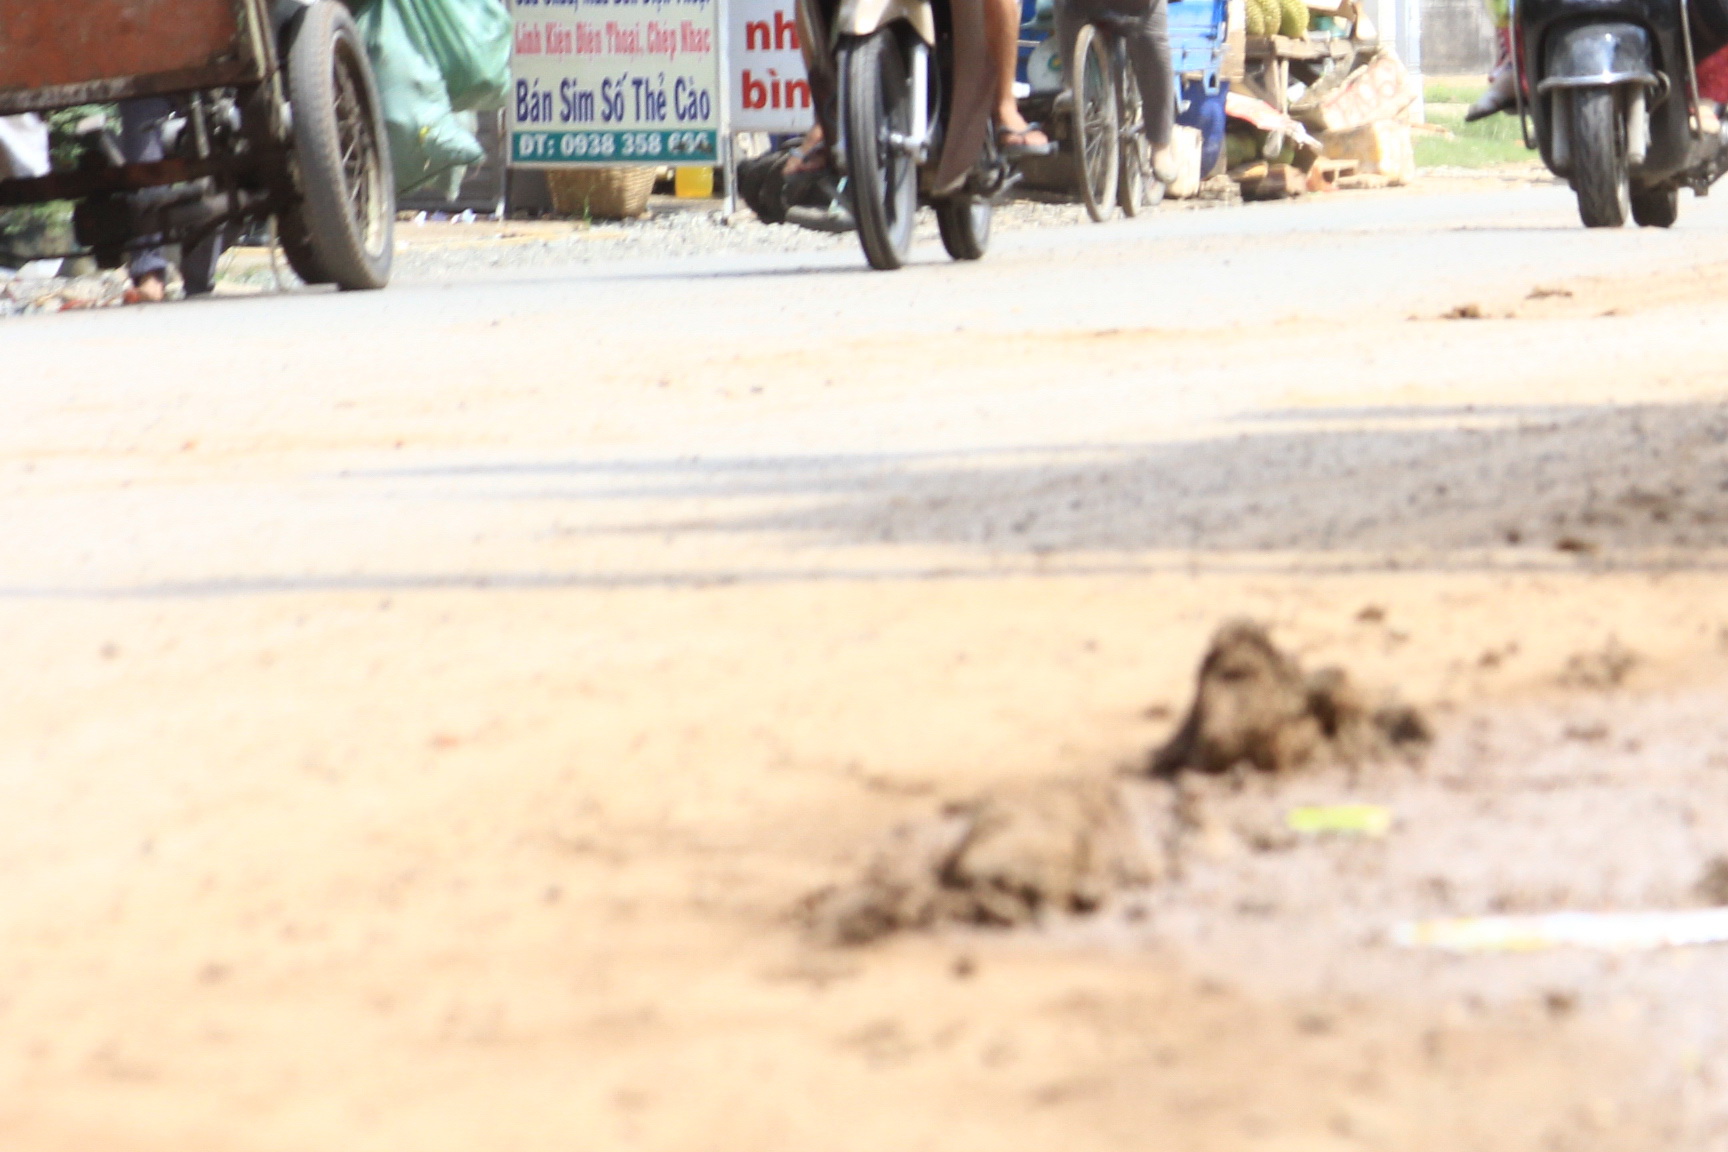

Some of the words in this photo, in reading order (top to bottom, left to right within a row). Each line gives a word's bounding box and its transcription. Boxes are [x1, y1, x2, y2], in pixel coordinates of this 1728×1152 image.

[515, 22, 541, 55] Linh
[647, 19, 678, 62] Chép
[516, 77, 552, 123] Bán
[560, 76, 594, 123] Sim
[601, 71, 629, 122] Số
[632, 71, 667, 122] Thẻ
[674, 75, 710, 122] Cào
[742, 68, 812, 110] bìn
[560, 132, 615, 157] 0938
[621, 132, 662, 157] 358
